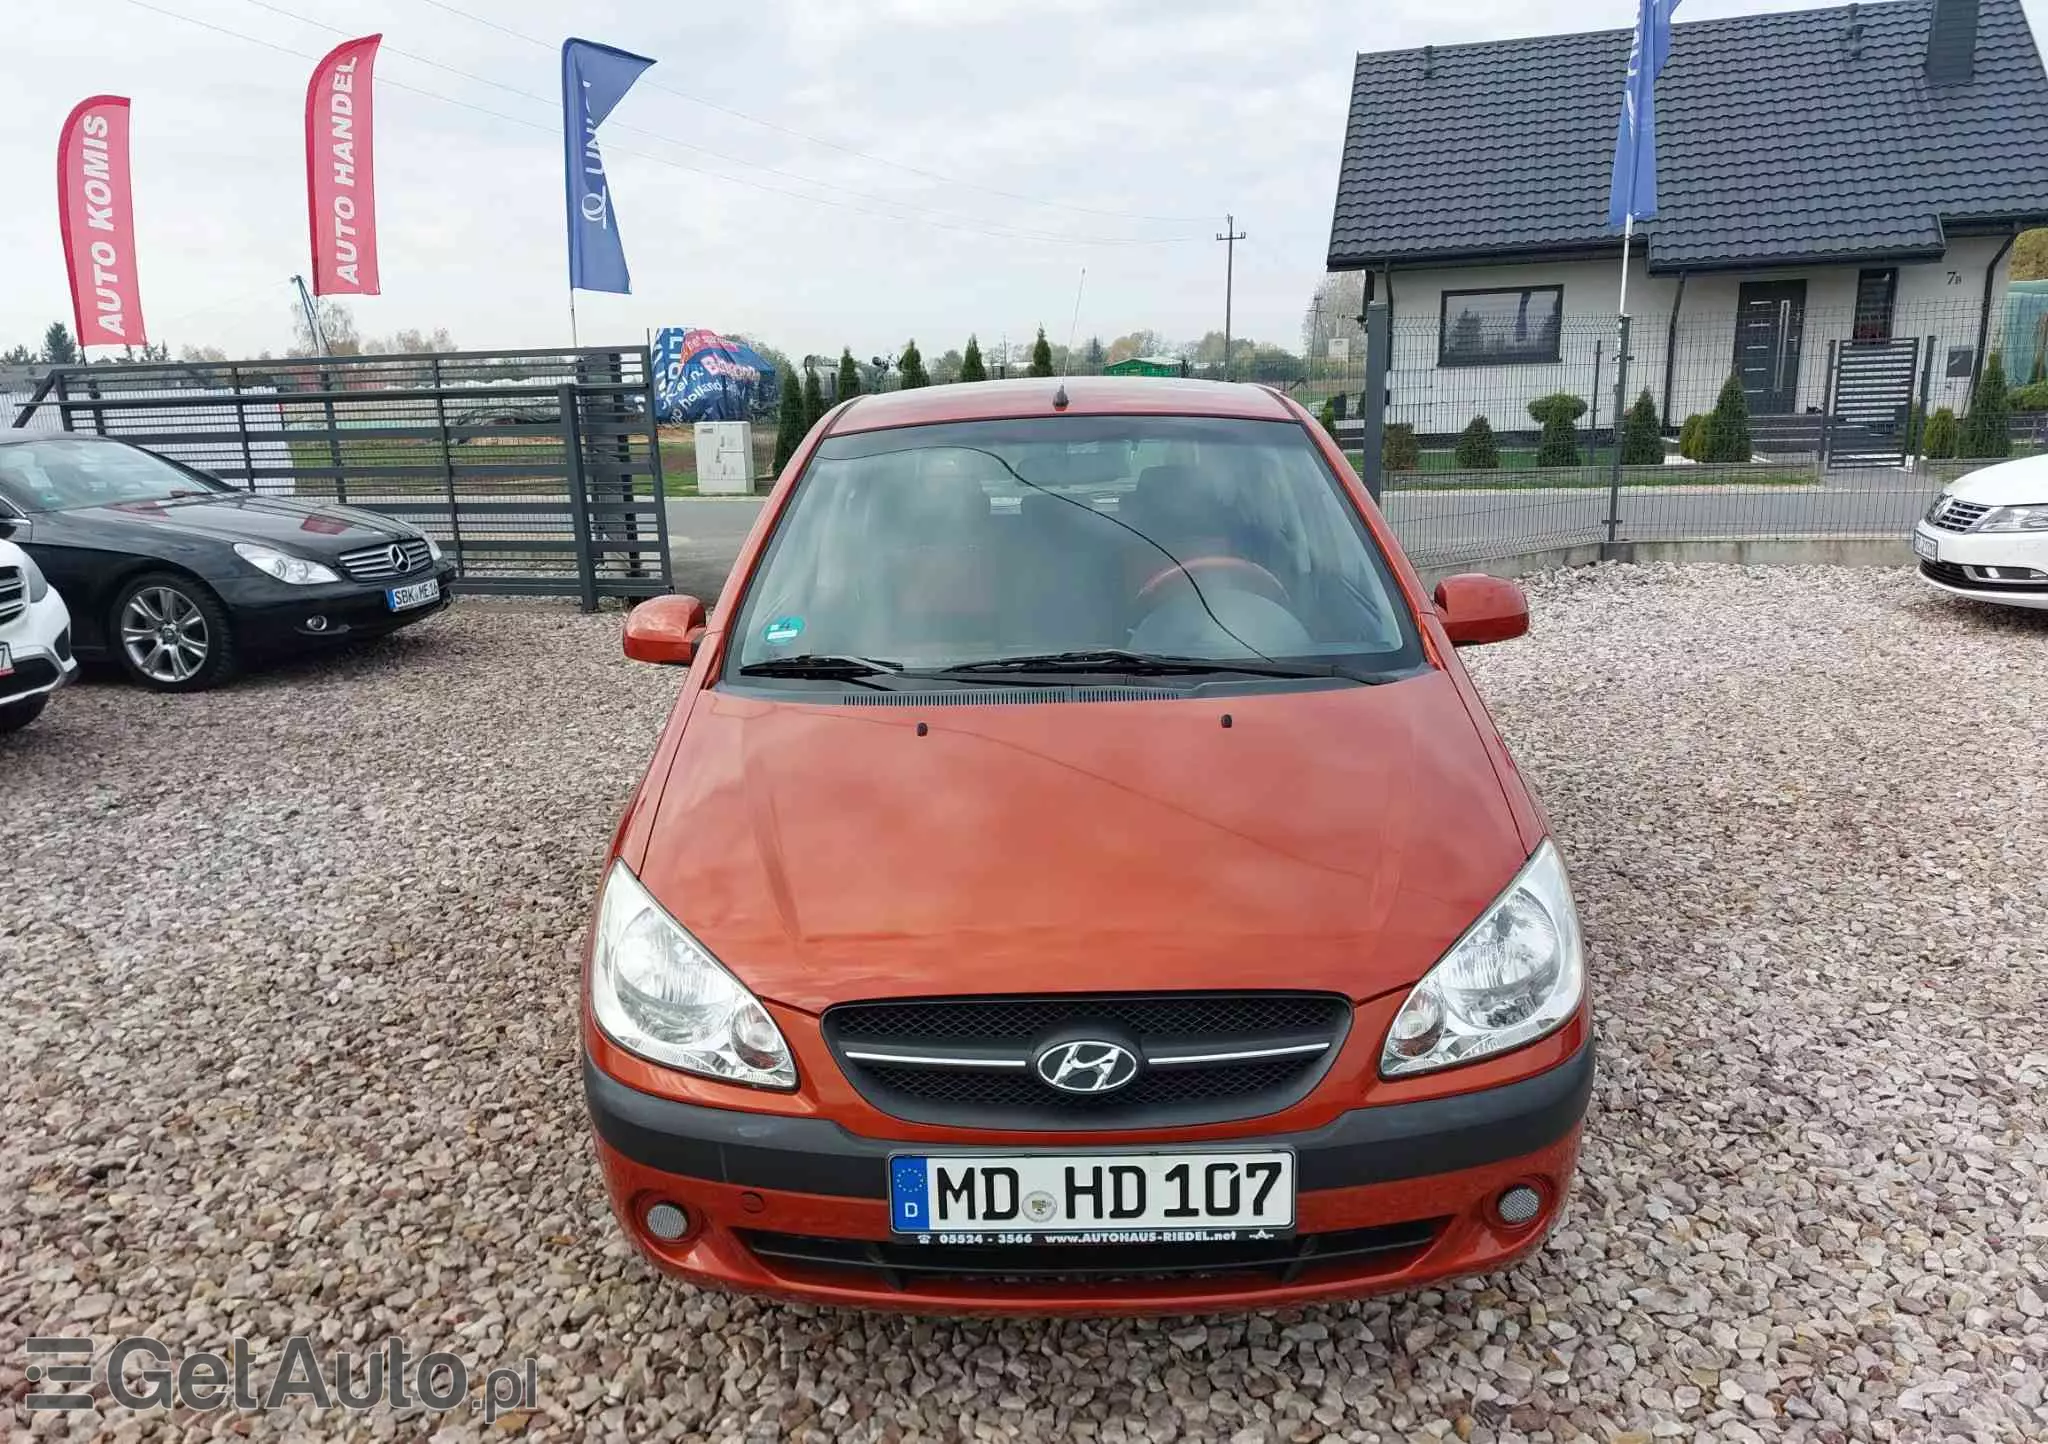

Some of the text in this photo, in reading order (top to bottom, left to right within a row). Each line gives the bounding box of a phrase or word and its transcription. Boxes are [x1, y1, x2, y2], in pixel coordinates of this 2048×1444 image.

[331, 55, 359, 286] AUTO HANDEL
[83, 114, 126, 337] AUTO KOMIS
[904, 1202, 918, 1218] D
[936, 1161, 1282, 1221] MD HD 107
[939, 1233, 983, 1244] 05524
[997, 1233, 1033, 1244] 3566
[1044, 1230, 1237, 1244] www.AUTOHAUS-RIEDEL.net
